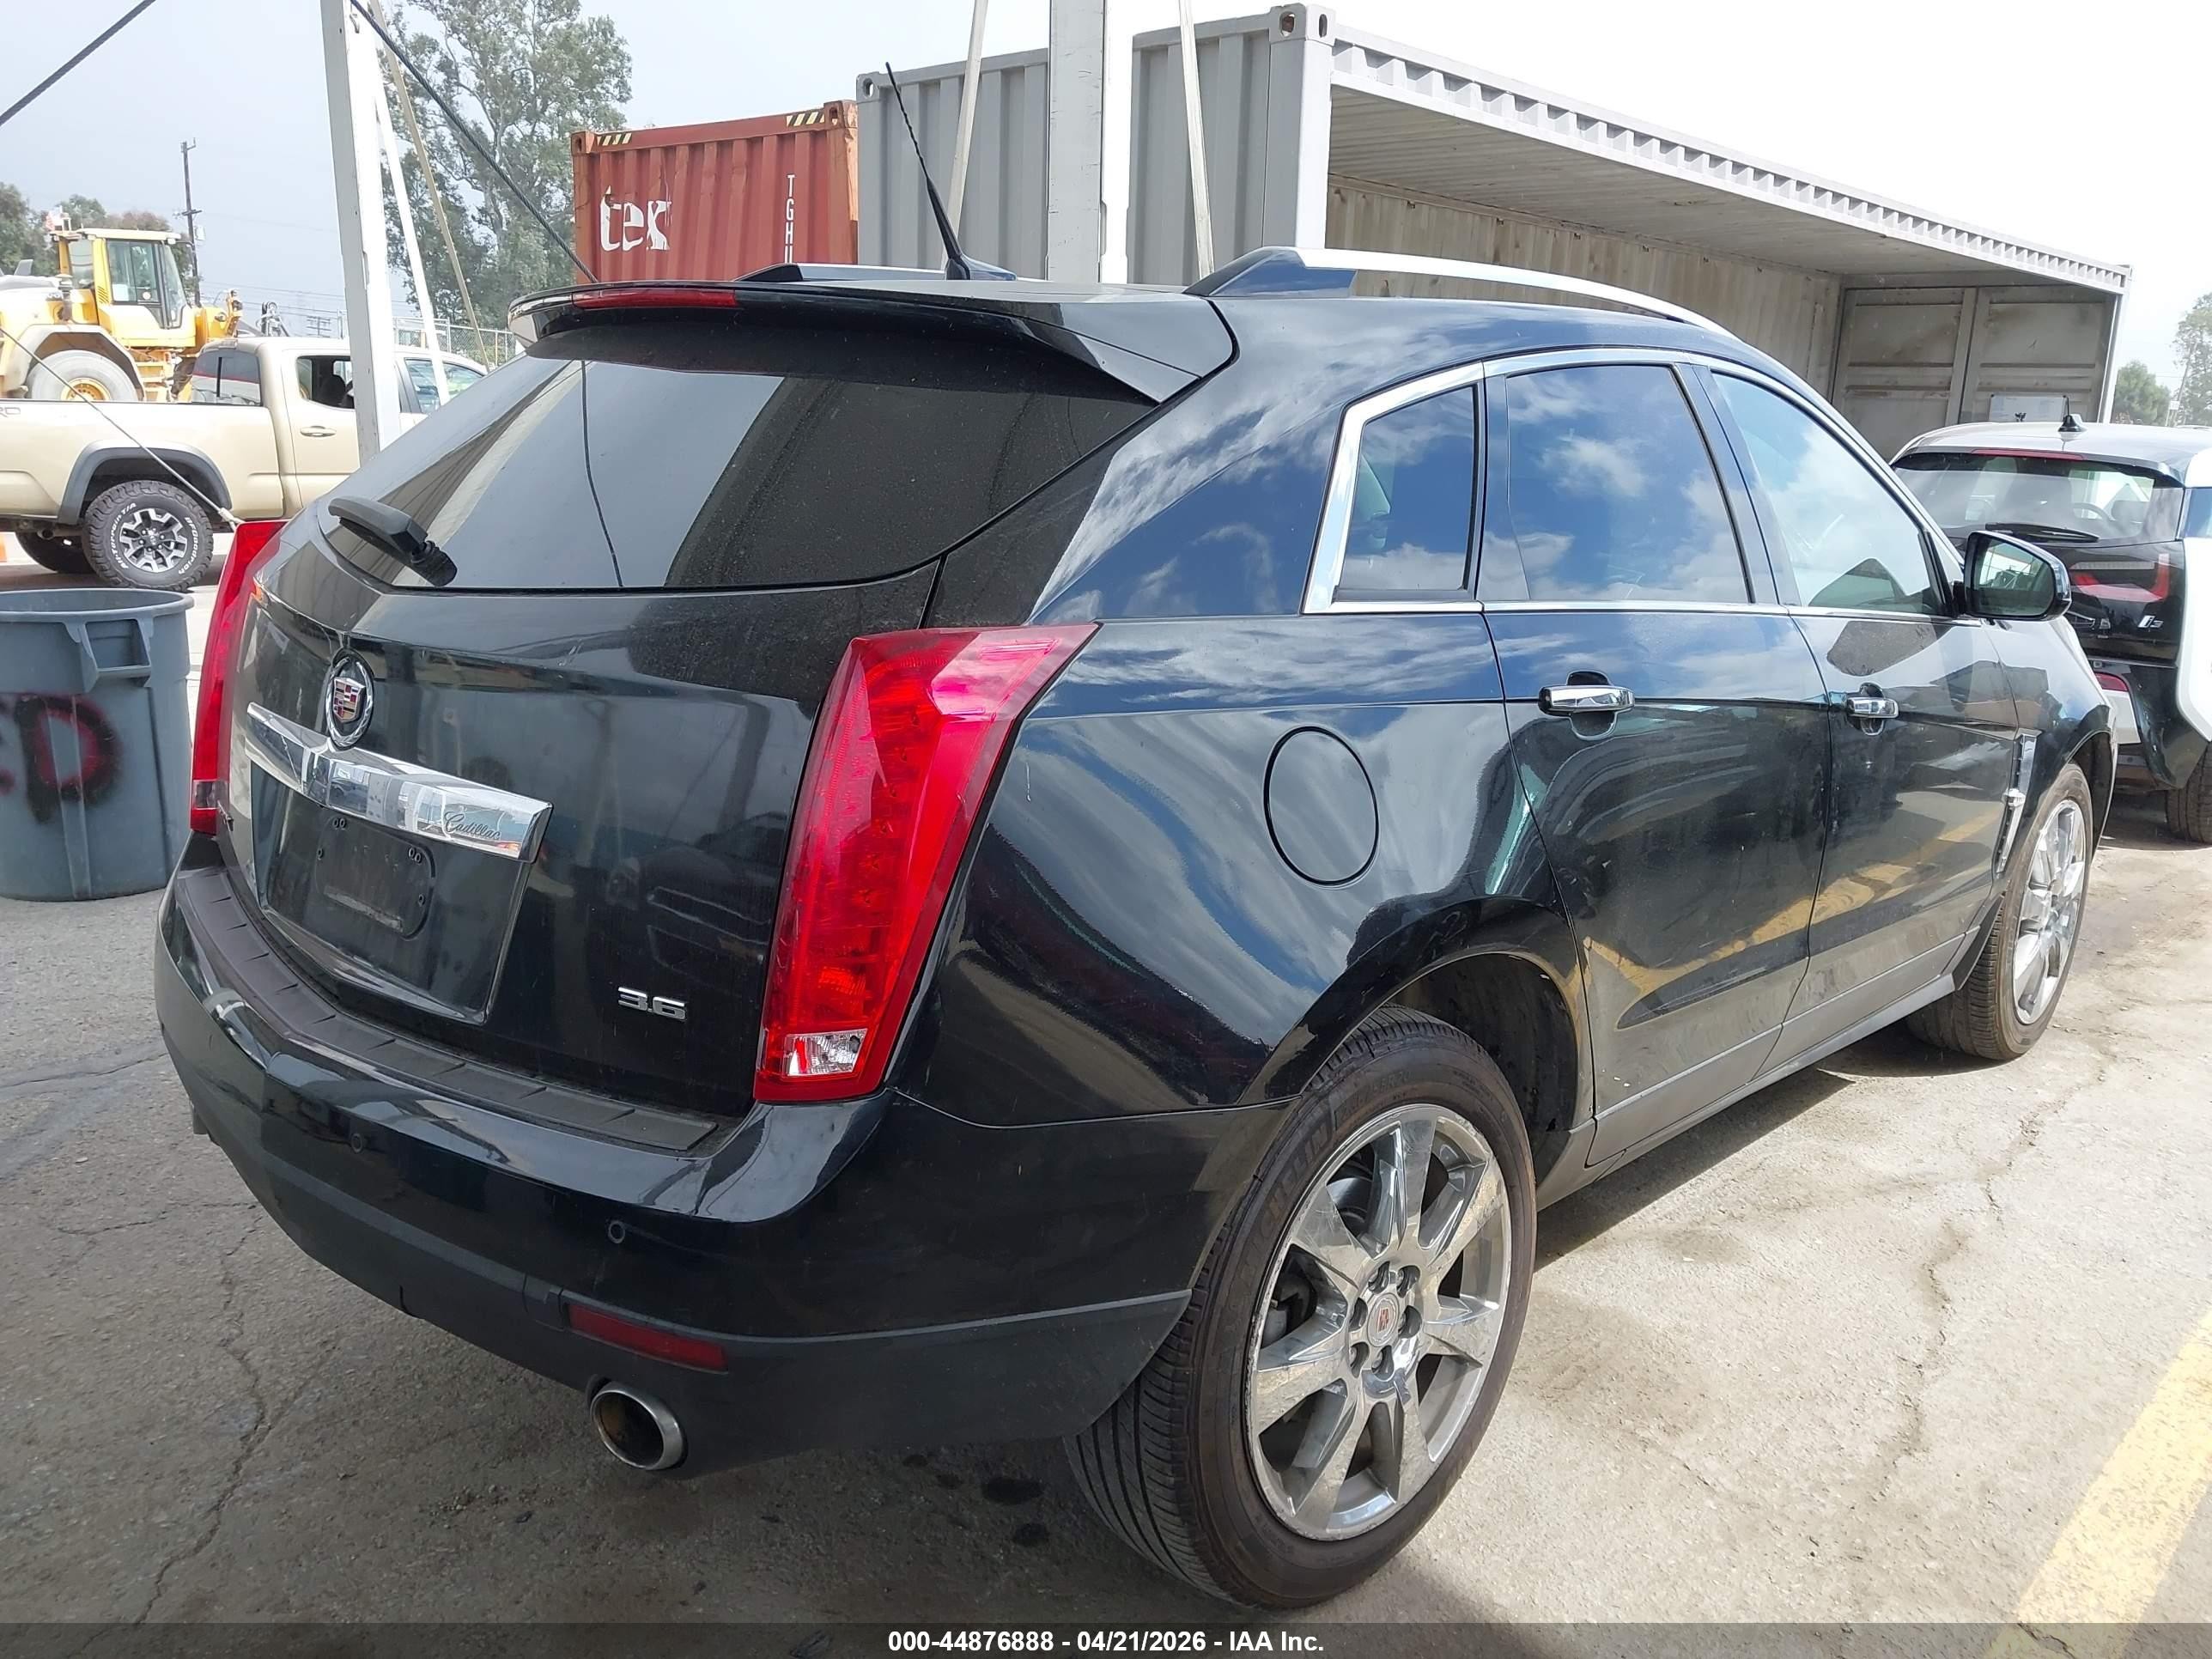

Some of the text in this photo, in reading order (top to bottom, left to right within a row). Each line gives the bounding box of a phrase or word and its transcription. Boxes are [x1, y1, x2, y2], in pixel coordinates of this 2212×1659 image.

[599, 185, 672, 252] tex
[2137, 615, 2165, 628] i3
[442, 811, 502, 841] Cadillac
[617, 986, 687, 1021] 3.6
